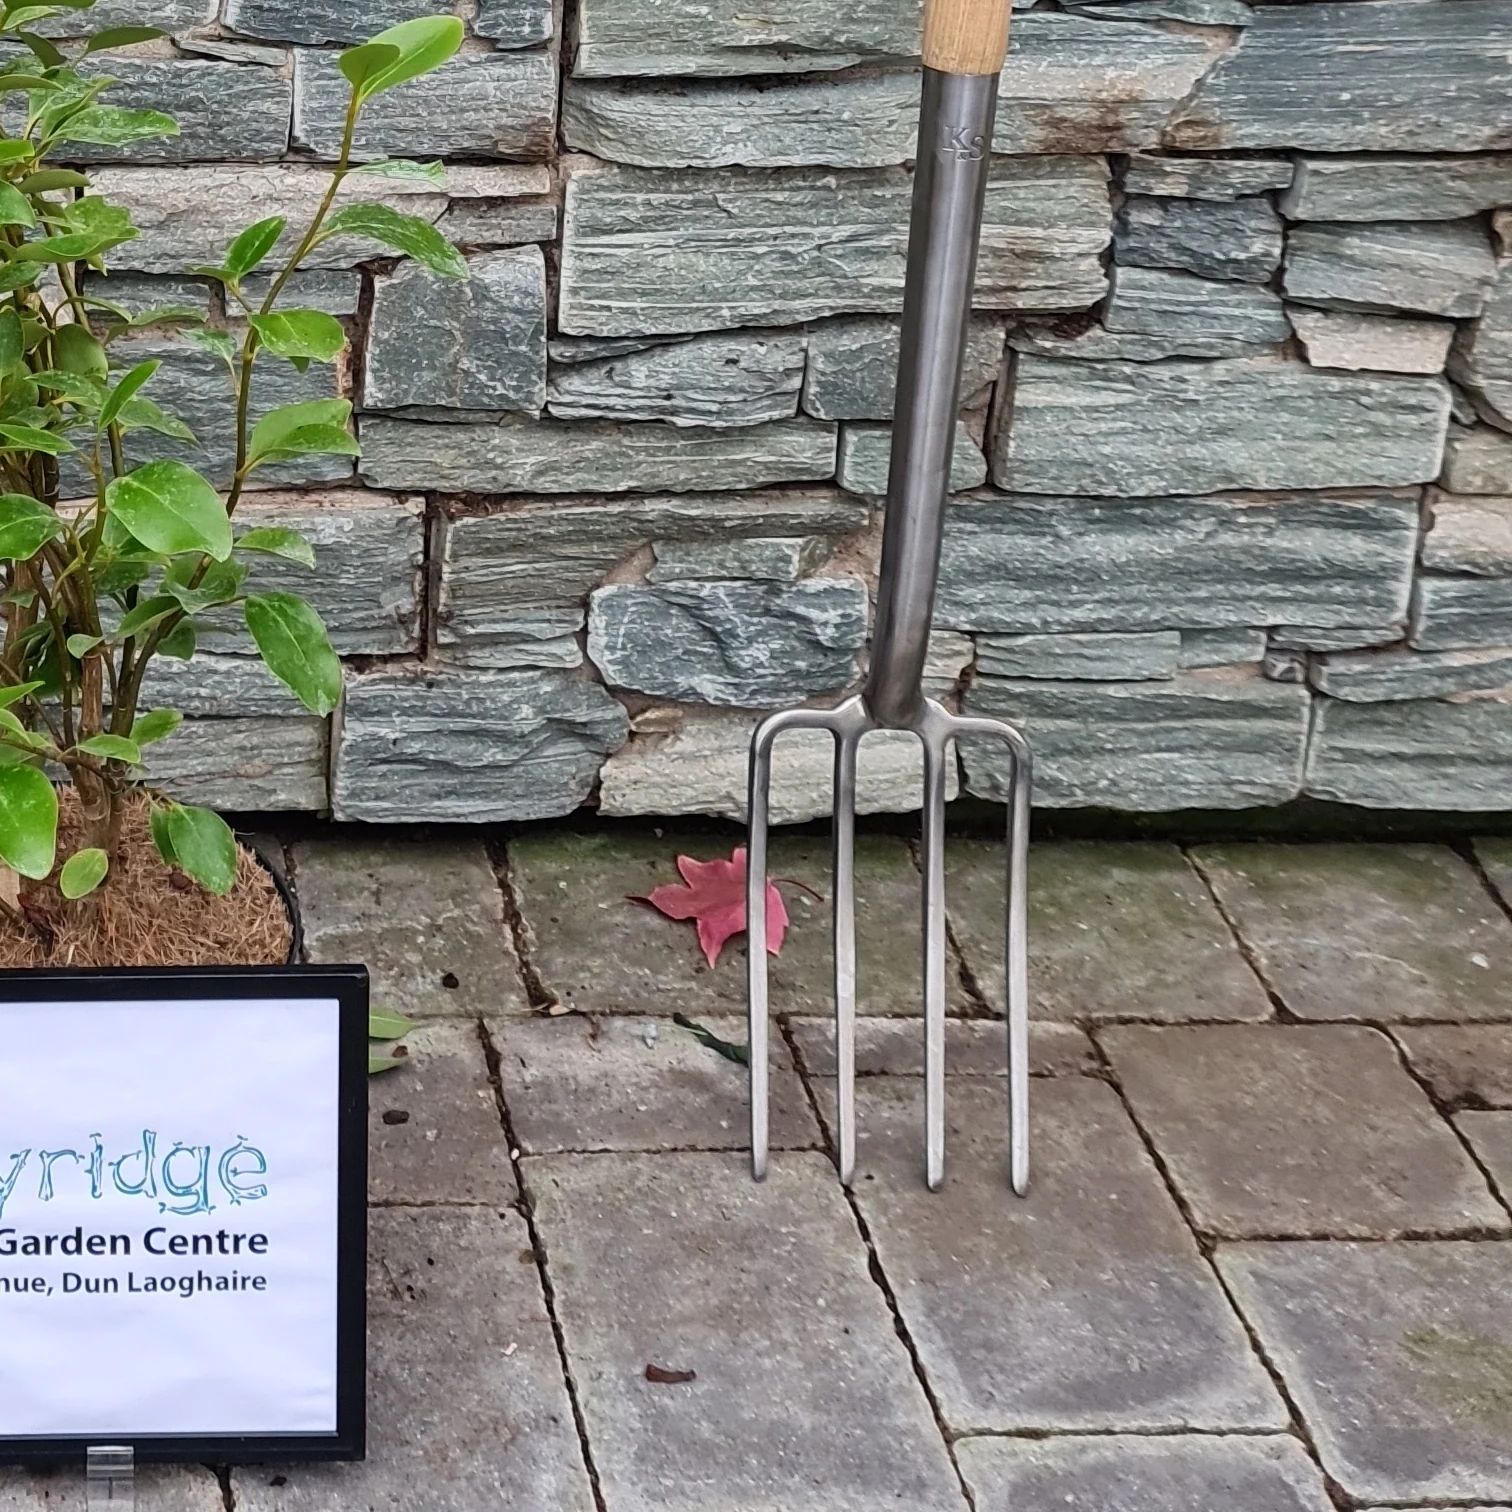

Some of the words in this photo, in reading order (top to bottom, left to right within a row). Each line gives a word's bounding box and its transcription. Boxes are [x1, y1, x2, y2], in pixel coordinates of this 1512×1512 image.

[143, 1227, 269, 1255] Centre
[62, 1272, 119, 1292] Dun
[128, 1270, 267, 1298] Laoghaire
